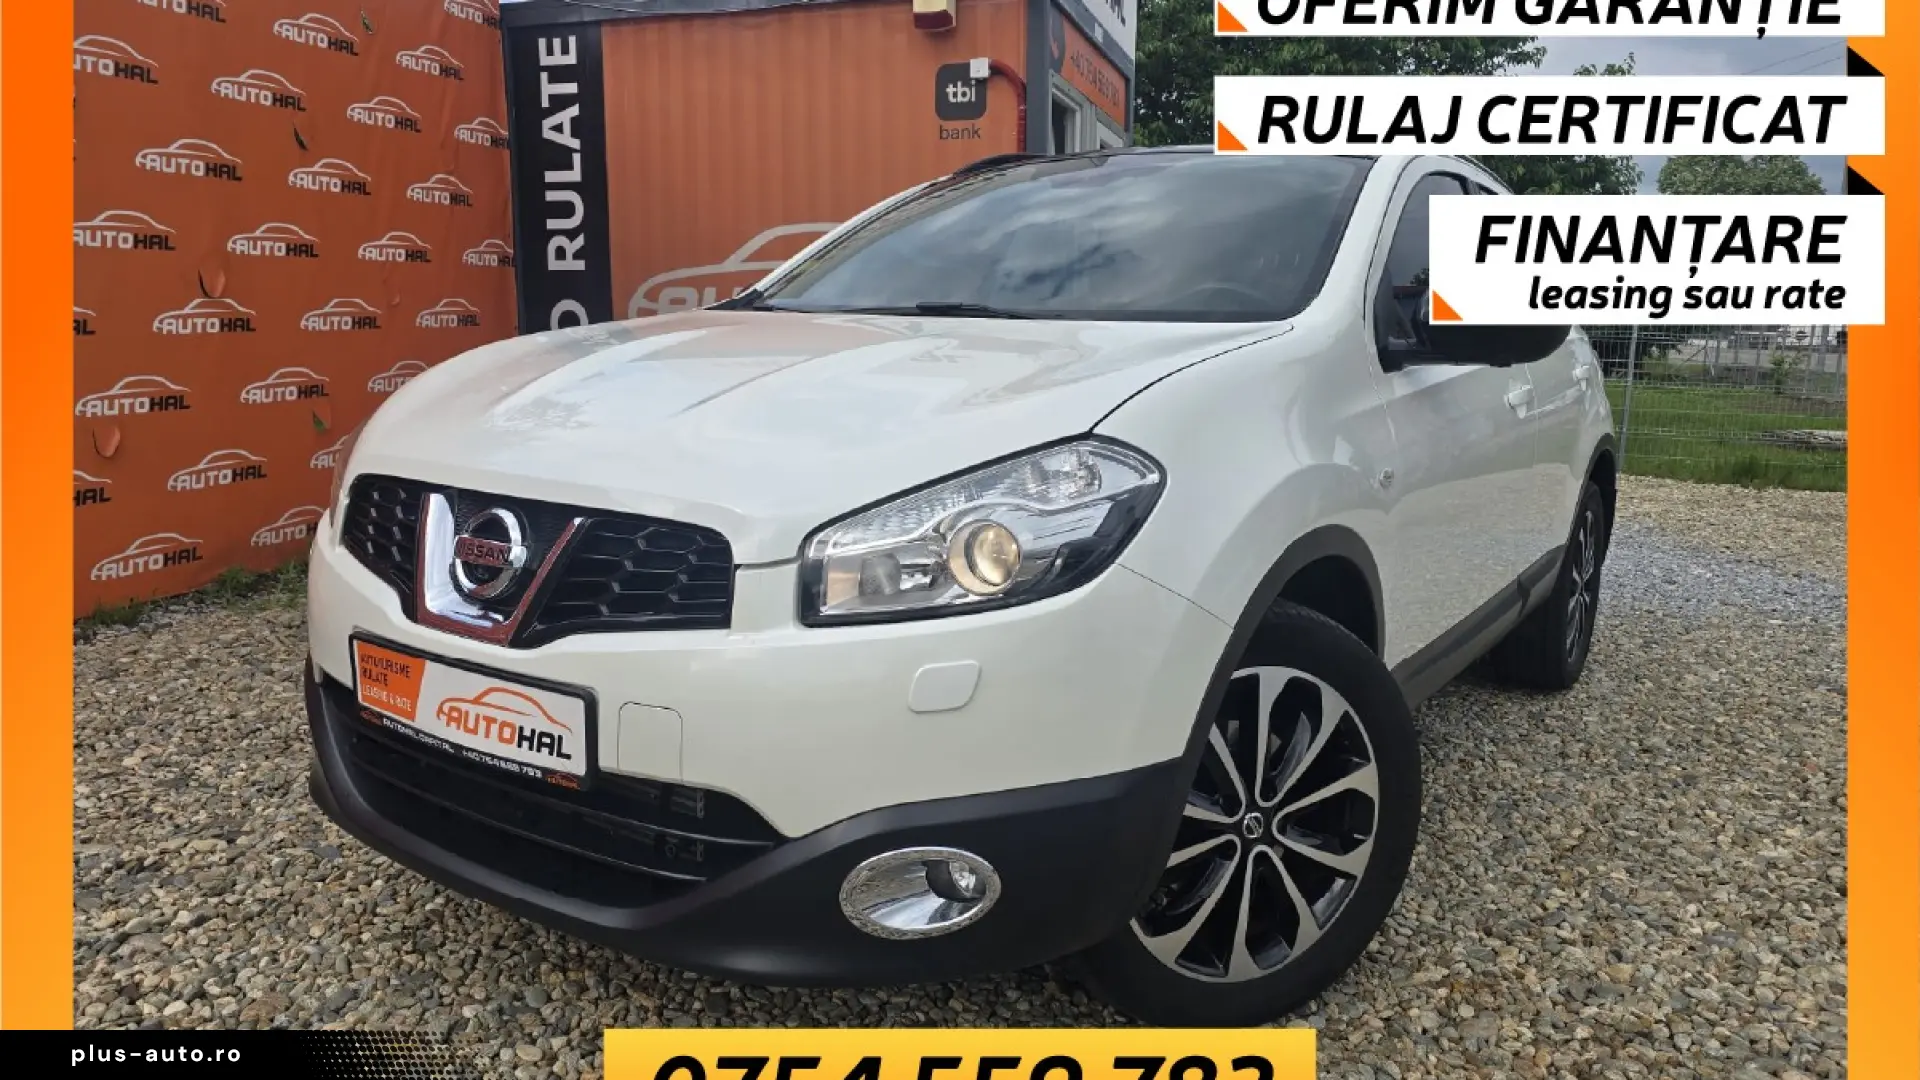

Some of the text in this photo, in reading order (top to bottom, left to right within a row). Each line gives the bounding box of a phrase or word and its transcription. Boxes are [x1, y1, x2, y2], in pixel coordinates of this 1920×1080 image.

[281, 25, 359, 56] AUTOHAL
[402, 55, 464, 80] AUTOHAL
[220, 82, 307, 112] AUTOHAL
[945, 79, 976, 103] tbi
[353, 107, 421, 133] AUTOHAL
[939, 123, 981, 140] bank
[538, 35, 586, 271] RULATE
[145, 154, 243, 182] AUTOHAL
[296, 173, 372, 196] AUTOHAL
[413, 188, 473, 208] AUTOHAL
[235, 239, 319, 259] AUTOHAL
[365, 248, 432, 263] AUTOHAL
[162, 317, 256, 335] AUTOHAL
[308, 316, 381, 331] AUTOHAL
[421, 314, 480, 328] AUTOHAL
[248, 384, 330, 405] AUTOHAL
[86, 395, 191, 418] AUTOHAL
[177, 464, 267, 491] AUTOHAL
[101, 547, 203, 581] AUTOHAL
[446, 705, 572, 761] AUTOHAL
